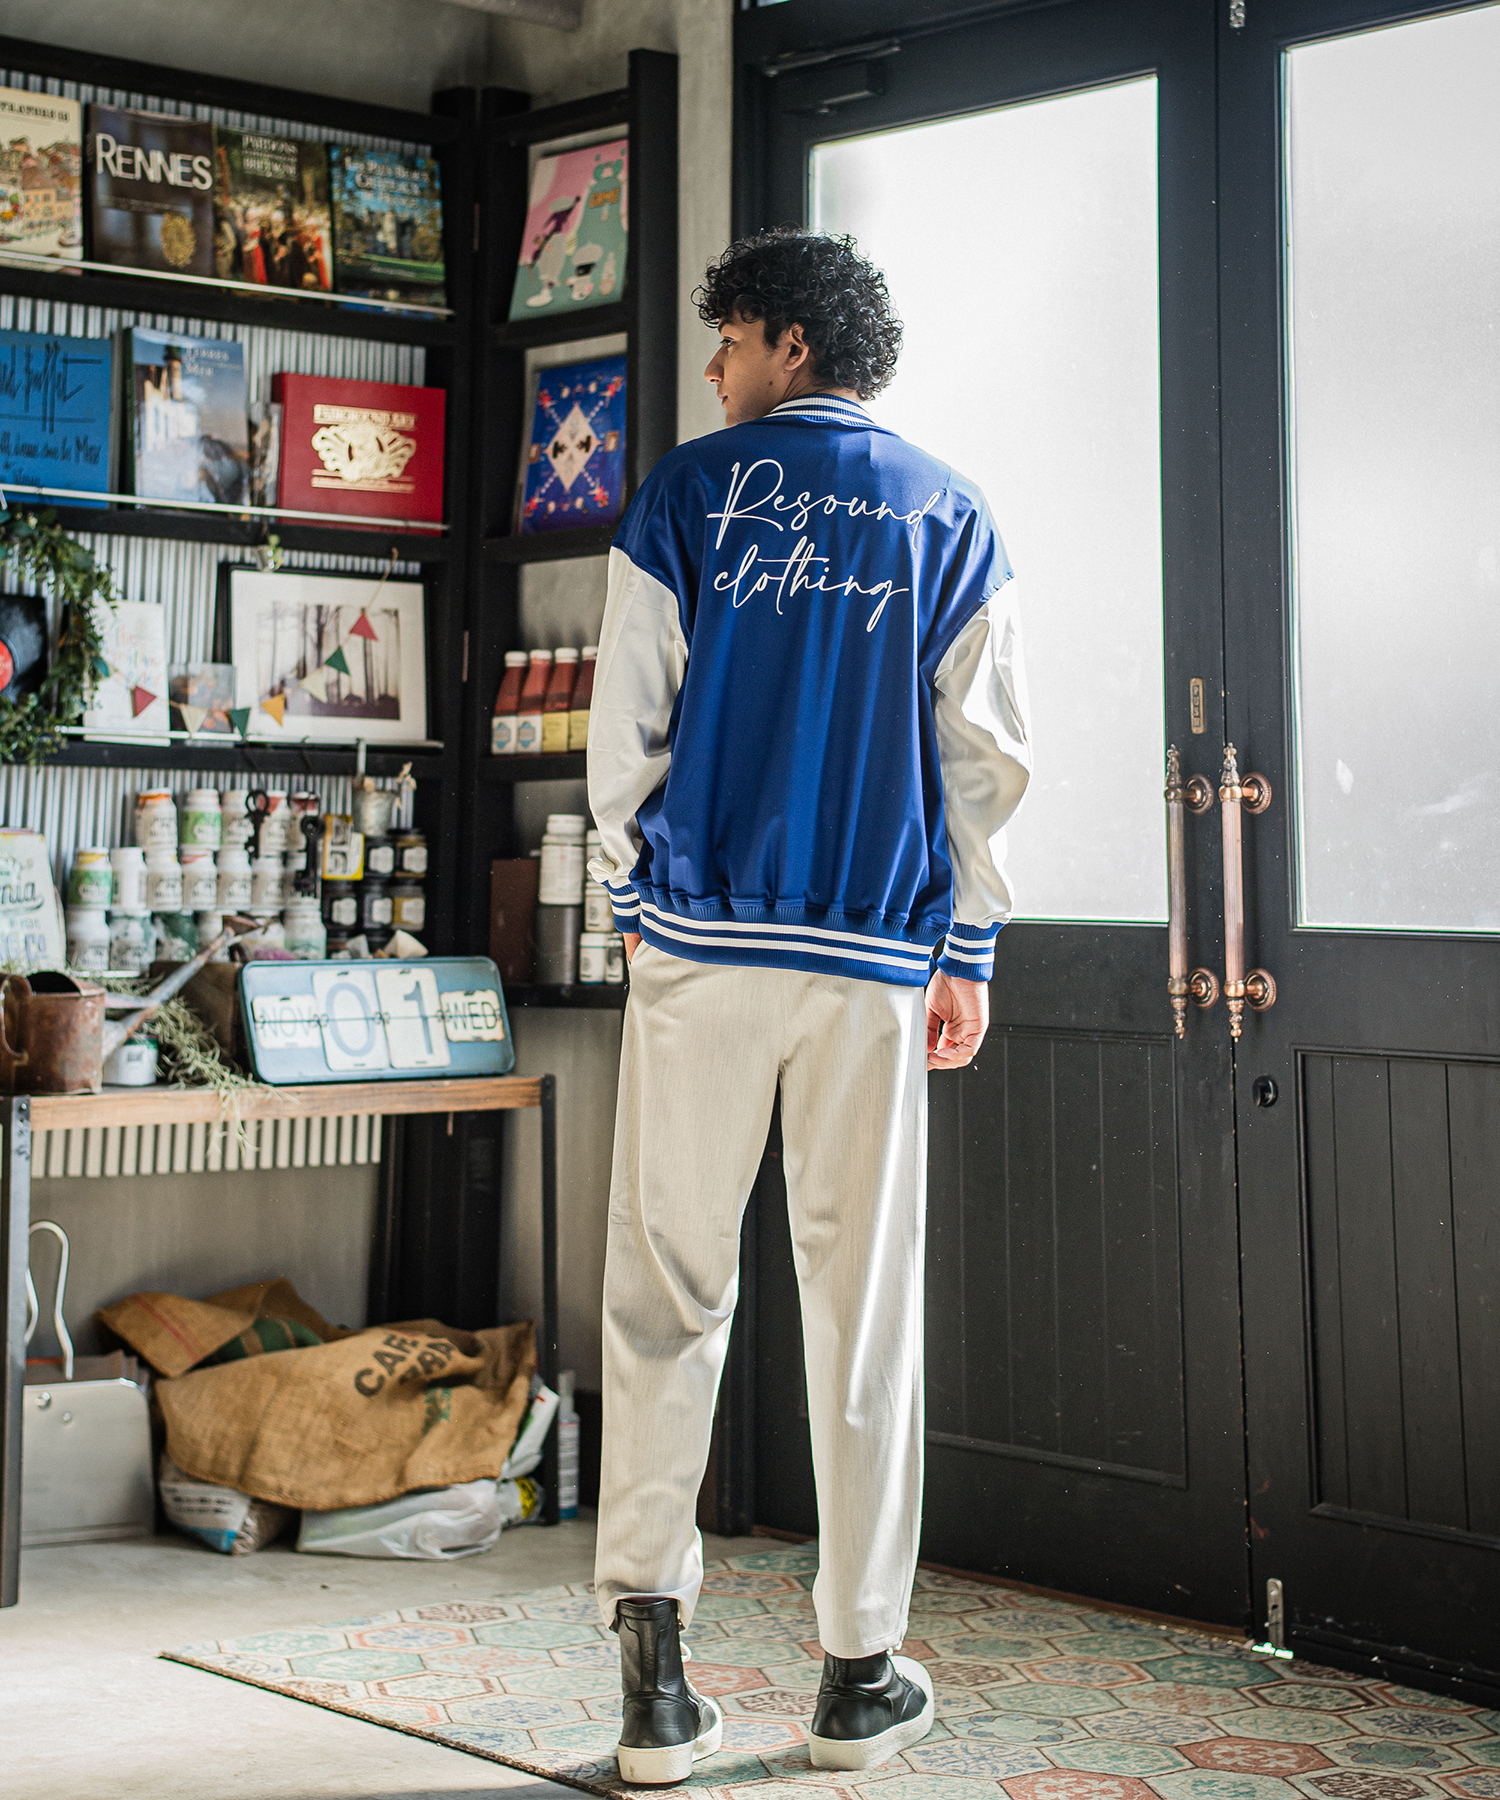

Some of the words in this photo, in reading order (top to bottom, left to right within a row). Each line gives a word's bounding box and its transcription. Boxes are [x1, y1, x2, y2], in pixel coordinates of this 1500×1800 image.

[96, 132, 213, 190] RENNES
[707, 458, 941, 552] Resound
[713, 535, 910, 633] clothing
[1193, 685, 1201, 727] PUSH
[261, 1004, 314, 1038] NOV
[446, 1001, 498, 1031] WED
